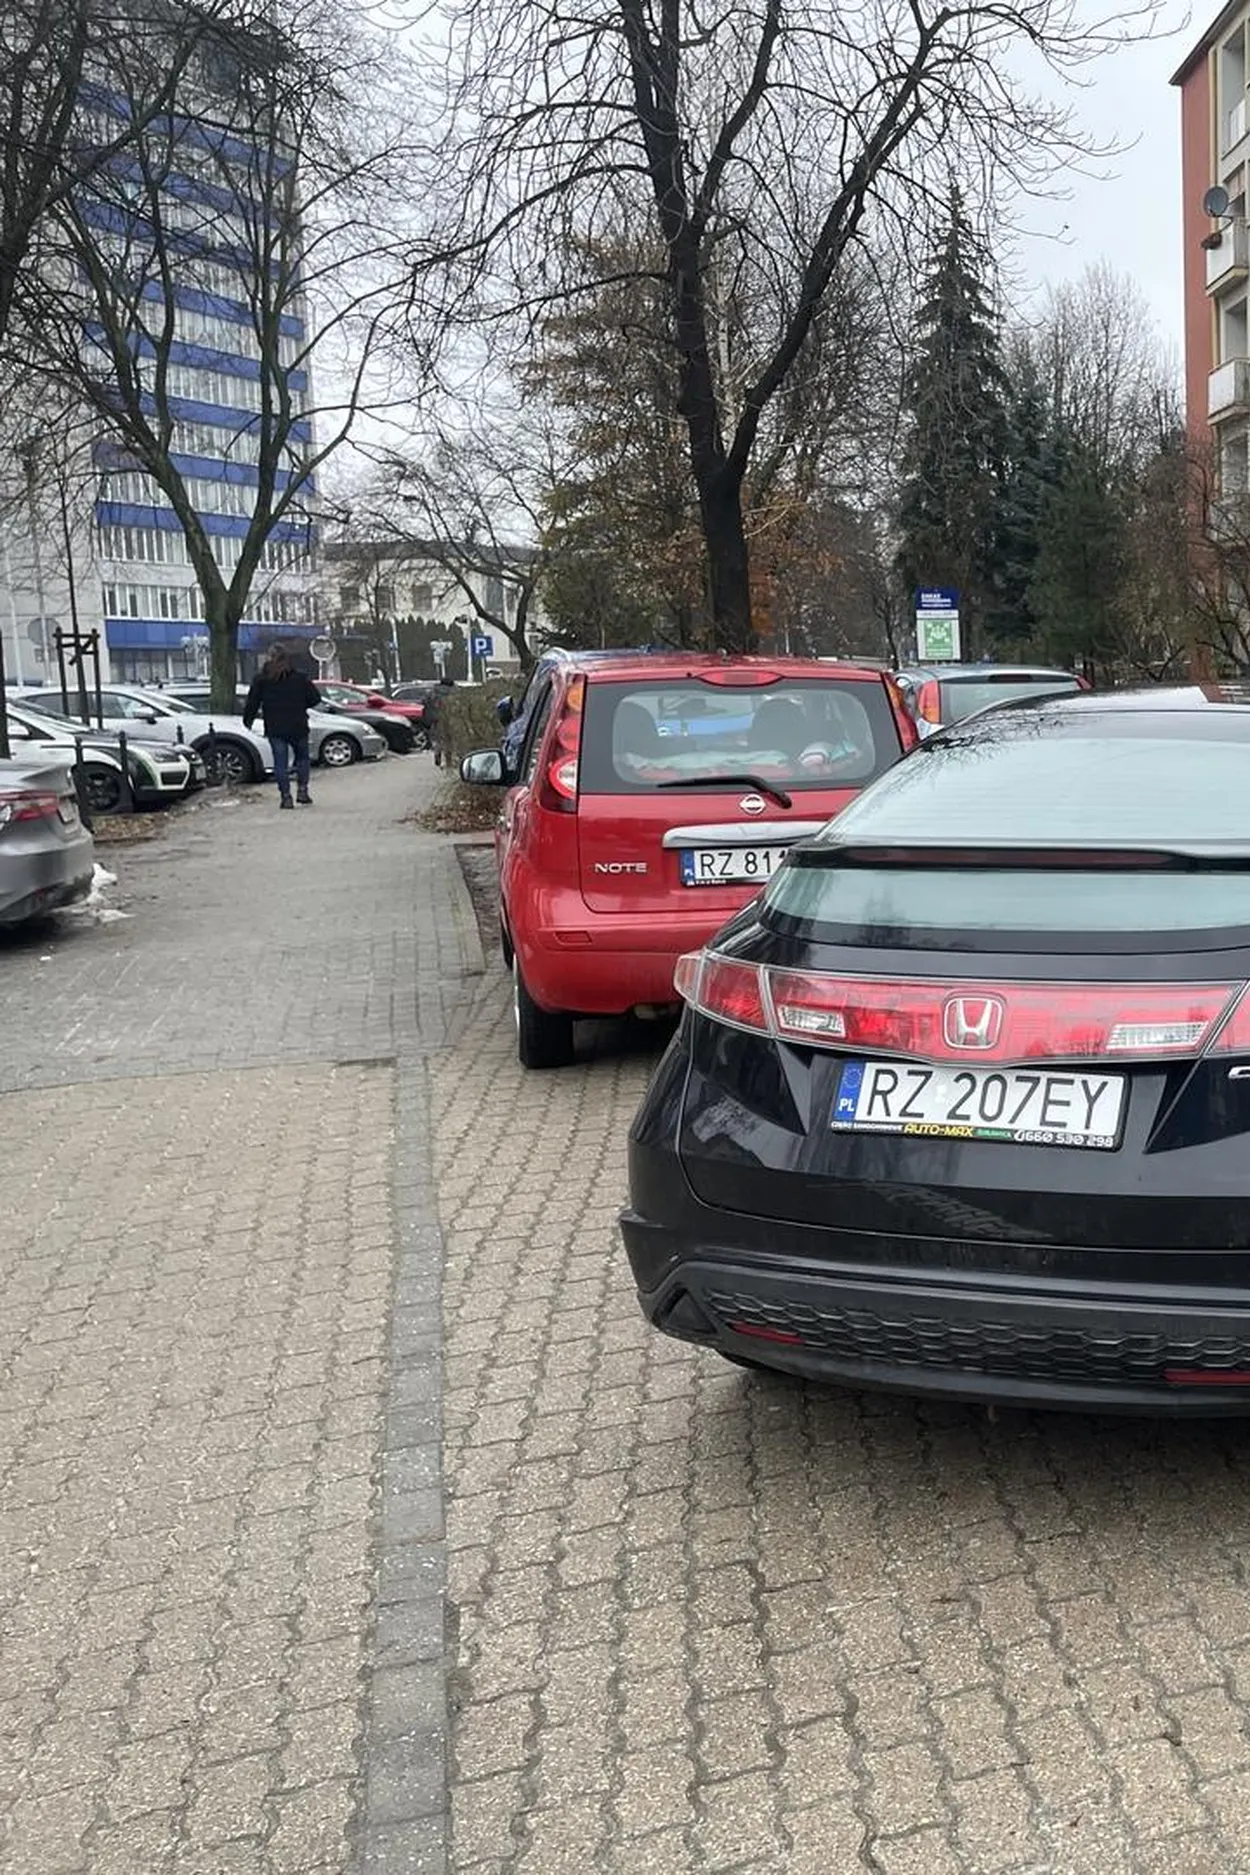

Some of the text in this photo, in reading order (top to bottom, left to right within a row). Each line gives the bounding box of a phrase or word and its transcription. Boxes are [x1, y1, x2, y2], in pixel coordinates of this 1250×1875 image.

[475, 637, 487, 654] P
[595, 861, 648, 873] NOTE
[700, 851, 733, 877] RZ
[839, 1098, 855, 1112] PL
[866, 1068, 1108, 1130] RZ 207EY
[903, 1122, 974, 1138] AUTO-MAX
